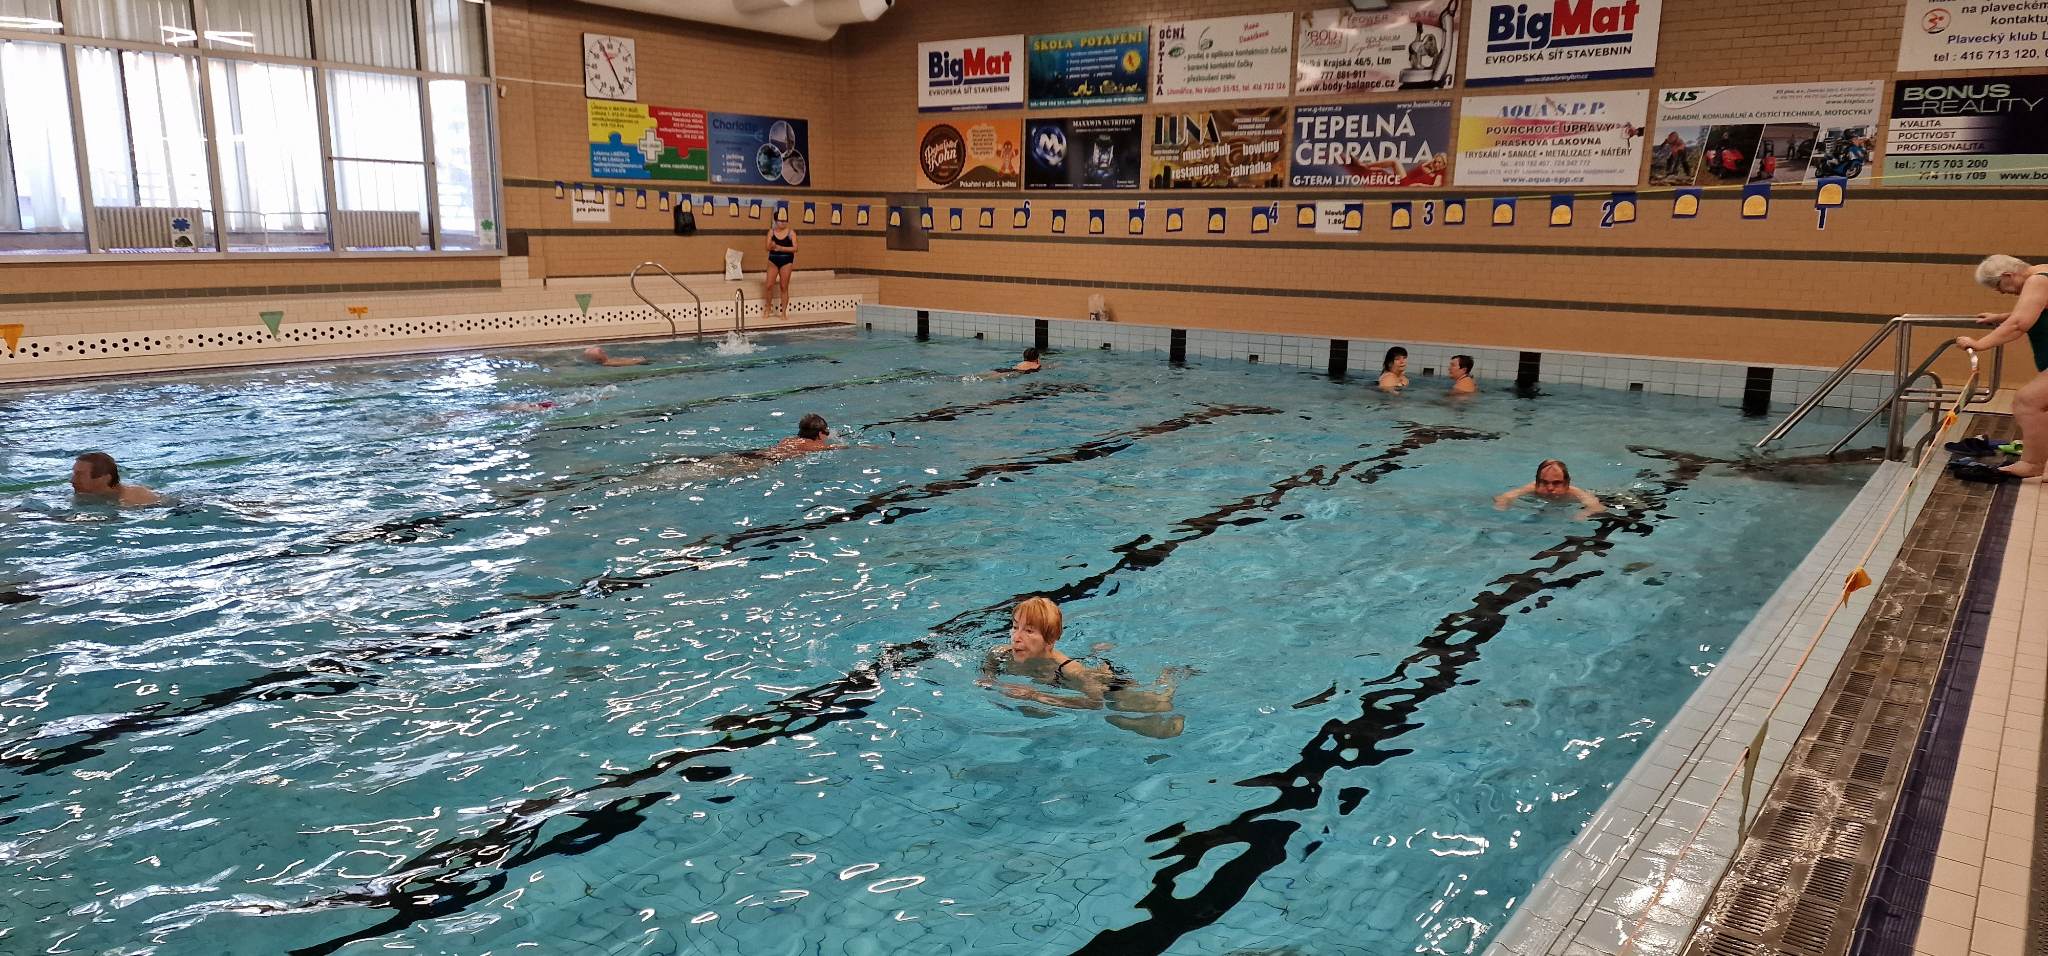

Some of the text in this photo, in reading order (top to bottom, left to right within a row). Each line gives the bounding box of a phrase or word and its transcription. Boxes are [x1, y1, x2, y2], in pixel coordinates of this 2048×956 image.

[1961, 5, 1977, 14] na
[1488, 0, 1640, 50] BigMat
[1947, 32, 2005, 45] Plavecký
[2009, 30, 2038, 41] klub
[1323, 57, 1352, 68] Krajská
[1486, 51, 1544, 65] EVROPSKÁ
[1566, 46, 1632, 59] STAVEBNIN
[1933, 52, 1949, 62] tel
[1988, 50, 2010, 60] 713
[928, 48, 1011, 85] BigMat
[1665, 91, 1699, 102] KIS
[1904, 84, 2011, 101] BONUS
[1499, 103, 1549, 118] AQUA
[1824, 107, 1873, 116] MOTOCYKLY
[1920, 97, 2045, 115] REALITY
[1296, 109, 1416, 139] TEPELNÁ
[1900, 119, 1942, 128] KVALITA
[1551, 137, 1602, 146] LAKOVNA
[1898, 131, 1956, 140] POCTIVOST
[1182, 147, 1209, 161] music
[1211, 143, 1231, 157] club
[1242, 140, 1280, 156] bowling
[1294, 138, 1434, 166] ČERPADLA
[1896, 141, 1985, 152] PROFESIONALITA
[1171, 161, 1272, 180] restaurace zahrádka
[1919, 160, 1940, 168] 775
[1943, 160, 1964, 168] 703
[1966, 160, 1988, 168] 200
[1292, 175, 1332, 186] G-TERM
[1268, 201, 1280, 223] 4
[1423, 200, 1436, 226] 3
[1600, 200, 1615, 229] 2
